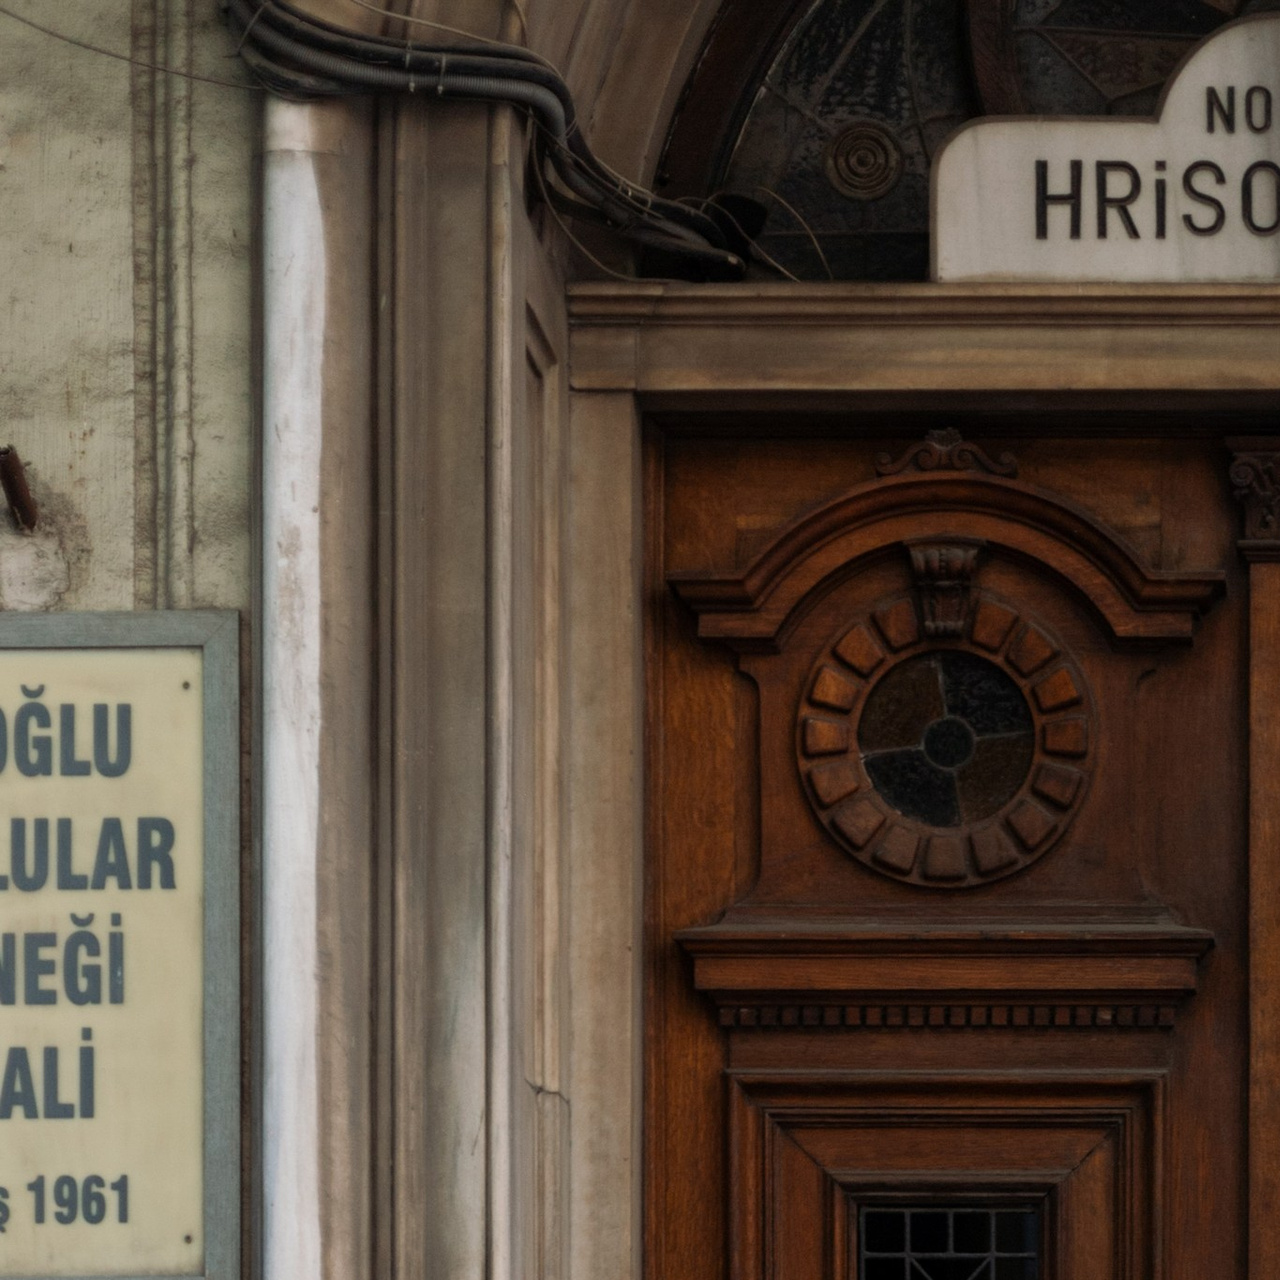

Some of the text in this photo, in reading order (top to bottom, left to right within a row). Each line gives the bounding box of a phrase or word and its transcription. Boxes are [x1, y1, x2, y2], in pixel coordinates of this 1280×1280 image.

[1206, 85, 1273, 134] NO
[0, 684, 132, 778] ĞLU
[0, 816, 177, 893] ULAR
[0, 1026, 95, 1120] ALİ
[27, 1174, 129, 1225] 1961
